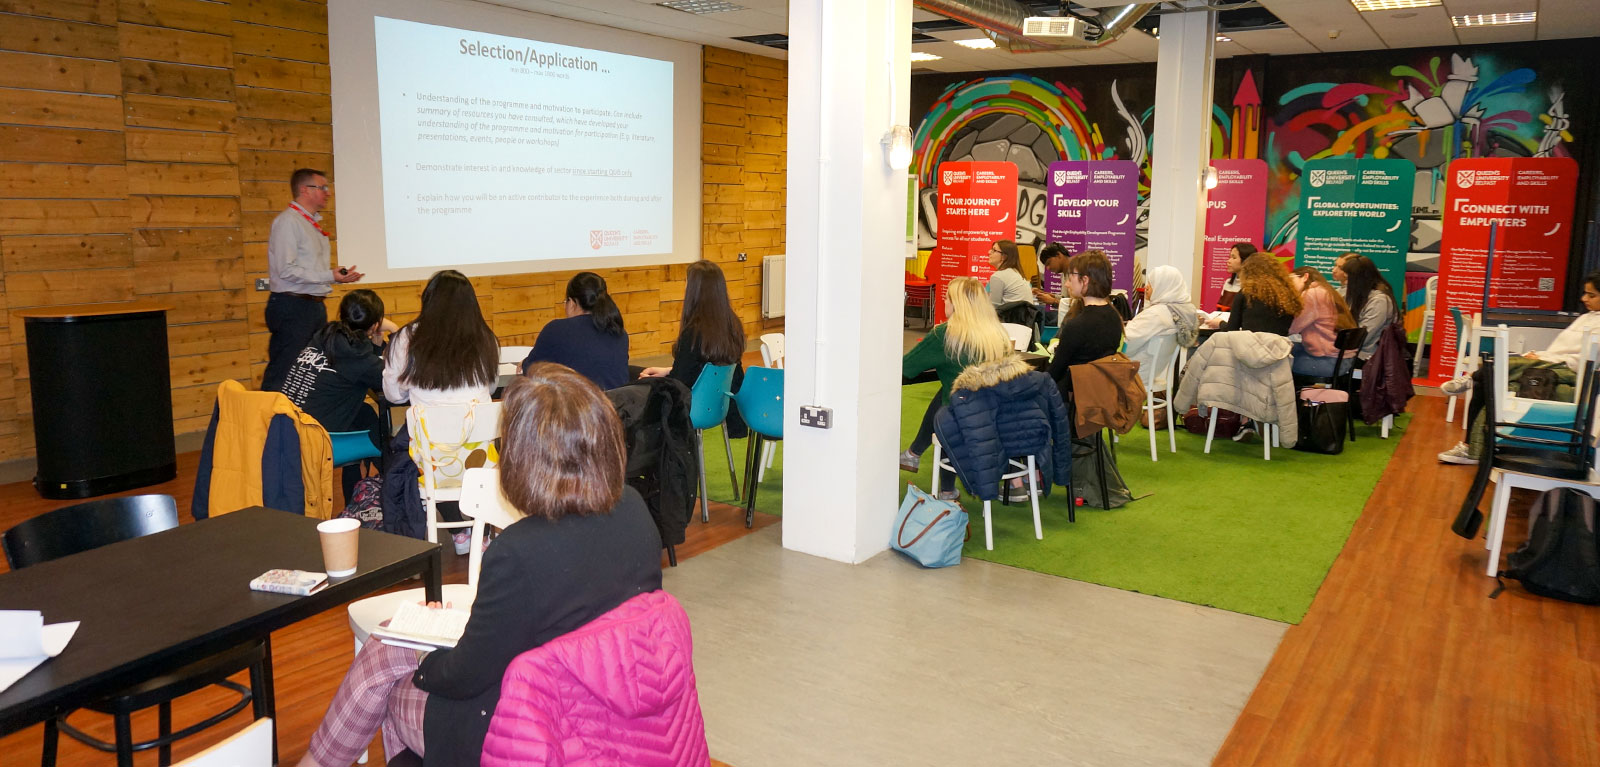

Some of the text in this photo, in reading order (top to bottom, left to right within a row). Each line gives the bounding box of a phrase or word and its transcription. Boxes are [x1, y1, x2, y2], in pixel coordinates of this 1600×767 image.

[460, 39, 598, 71] Selection/Application
[417, 92, 469, 105] Understanding
[492, 100, 529, 109] programme
[542, 104, 574, 113] motivation
[417, 107, 451, 117] summary
[462, 110, 493, 119] resources
[588, 120, 616, 128] developed
[418, 120, 468, 130] understanding
[470, 122, 478, 130] of
[479, 122, 490, 130] the
[492, 124, 528, 133] programme
[542, 127, 574, 136] motivation
[575, 128, 583, 137] for
[584, 130, 618, 139] participation
[418, 132, 468, 142] presentations,
[470, 134, 493, 144] events,
[495, 136, 516, 145] people
[416, 163, 462, 172] Demonstrate
[464, 163, 489, 172] interest
[499, 165, 511, 173] and
[512, 165, 545, 175] knowledge
[417, 194, 443, 202] Explain
[461, 194, 474, 202] you
[580, 194, 609, 202] experience
[1206, 201, 1226, 209] PUS
[1461, 205, 1550, 214] CONNECT WITH
[431, 207, 472, 216] programme
[1460, 217, 1527, 227] EMPLOYERS
